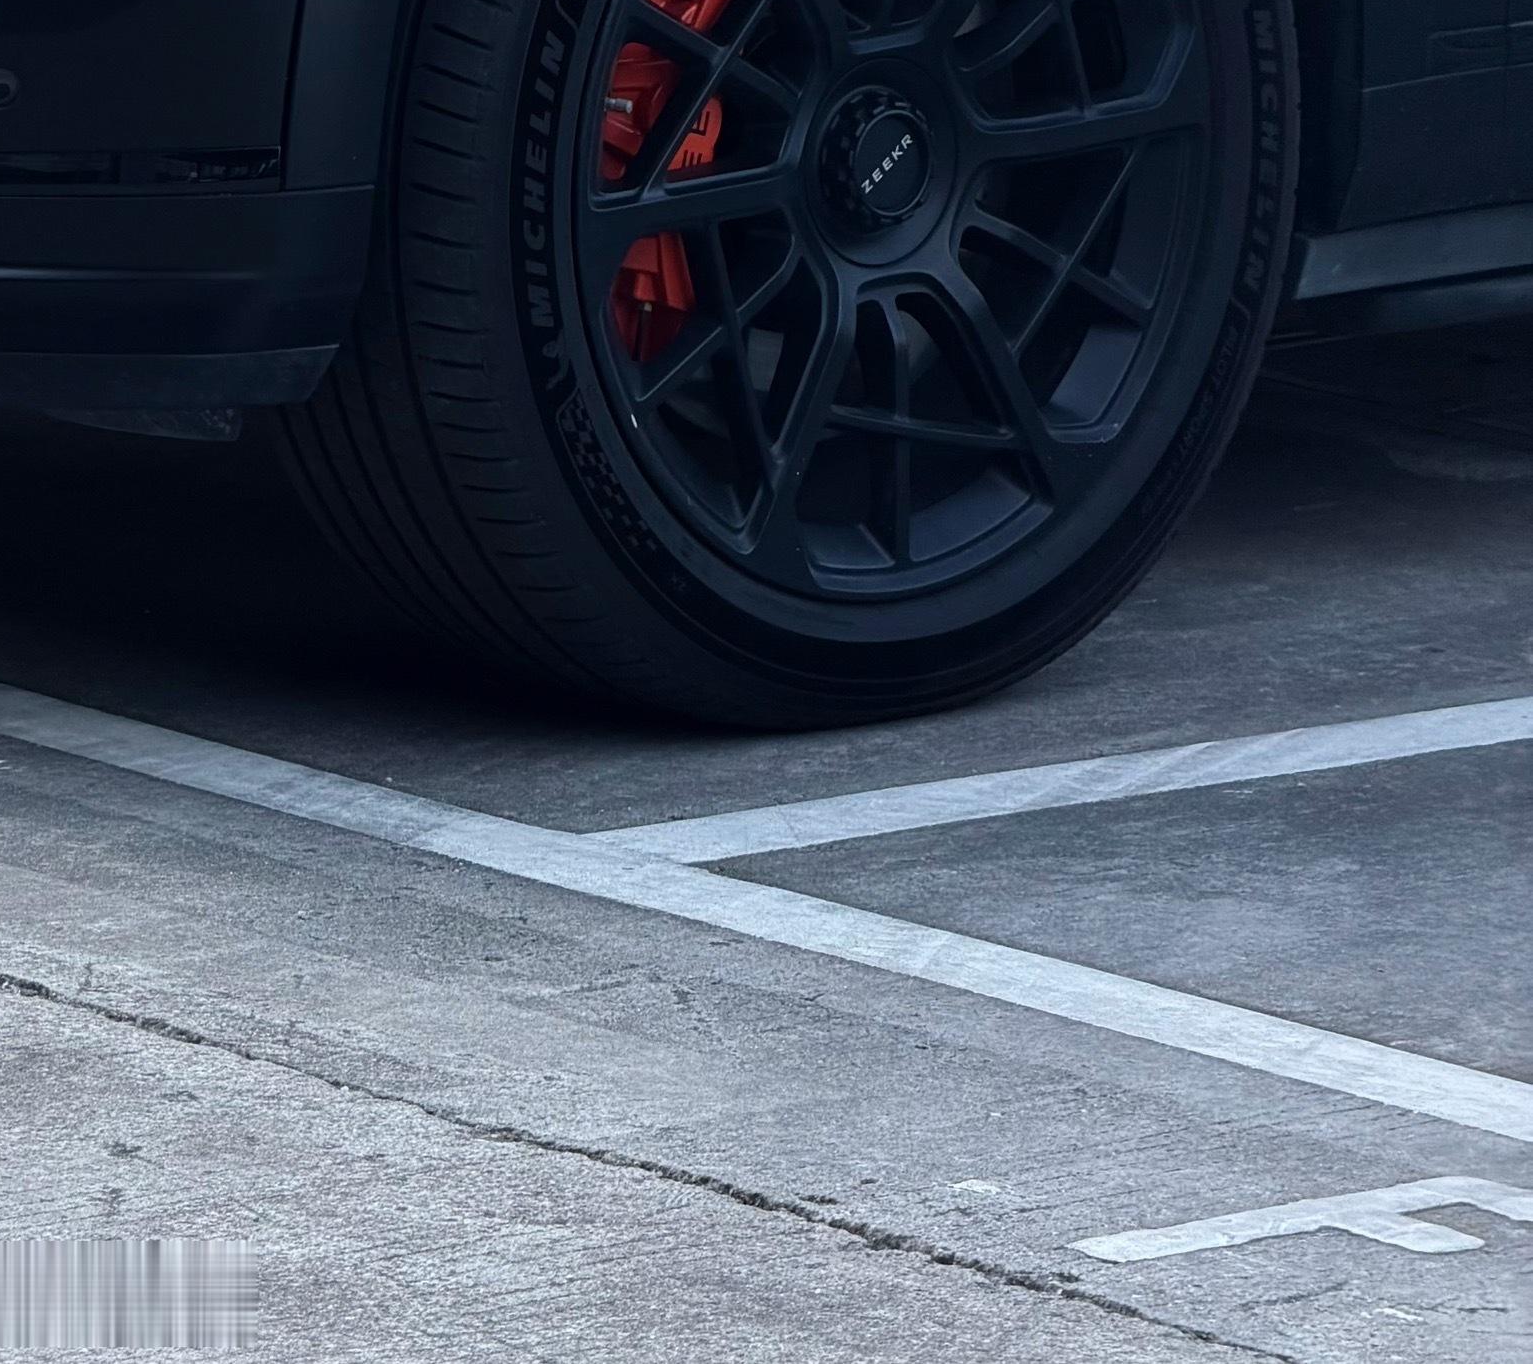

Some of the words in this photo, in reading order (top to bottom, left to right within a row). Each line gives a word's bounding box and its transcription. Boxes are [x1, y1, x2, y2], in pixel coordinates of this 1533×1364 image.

[522, 29, 565, 328] MICHELIN
[860, 133, 914, 195] ZEEKR
[1241, 8, 1278, 293] MICHELIN
